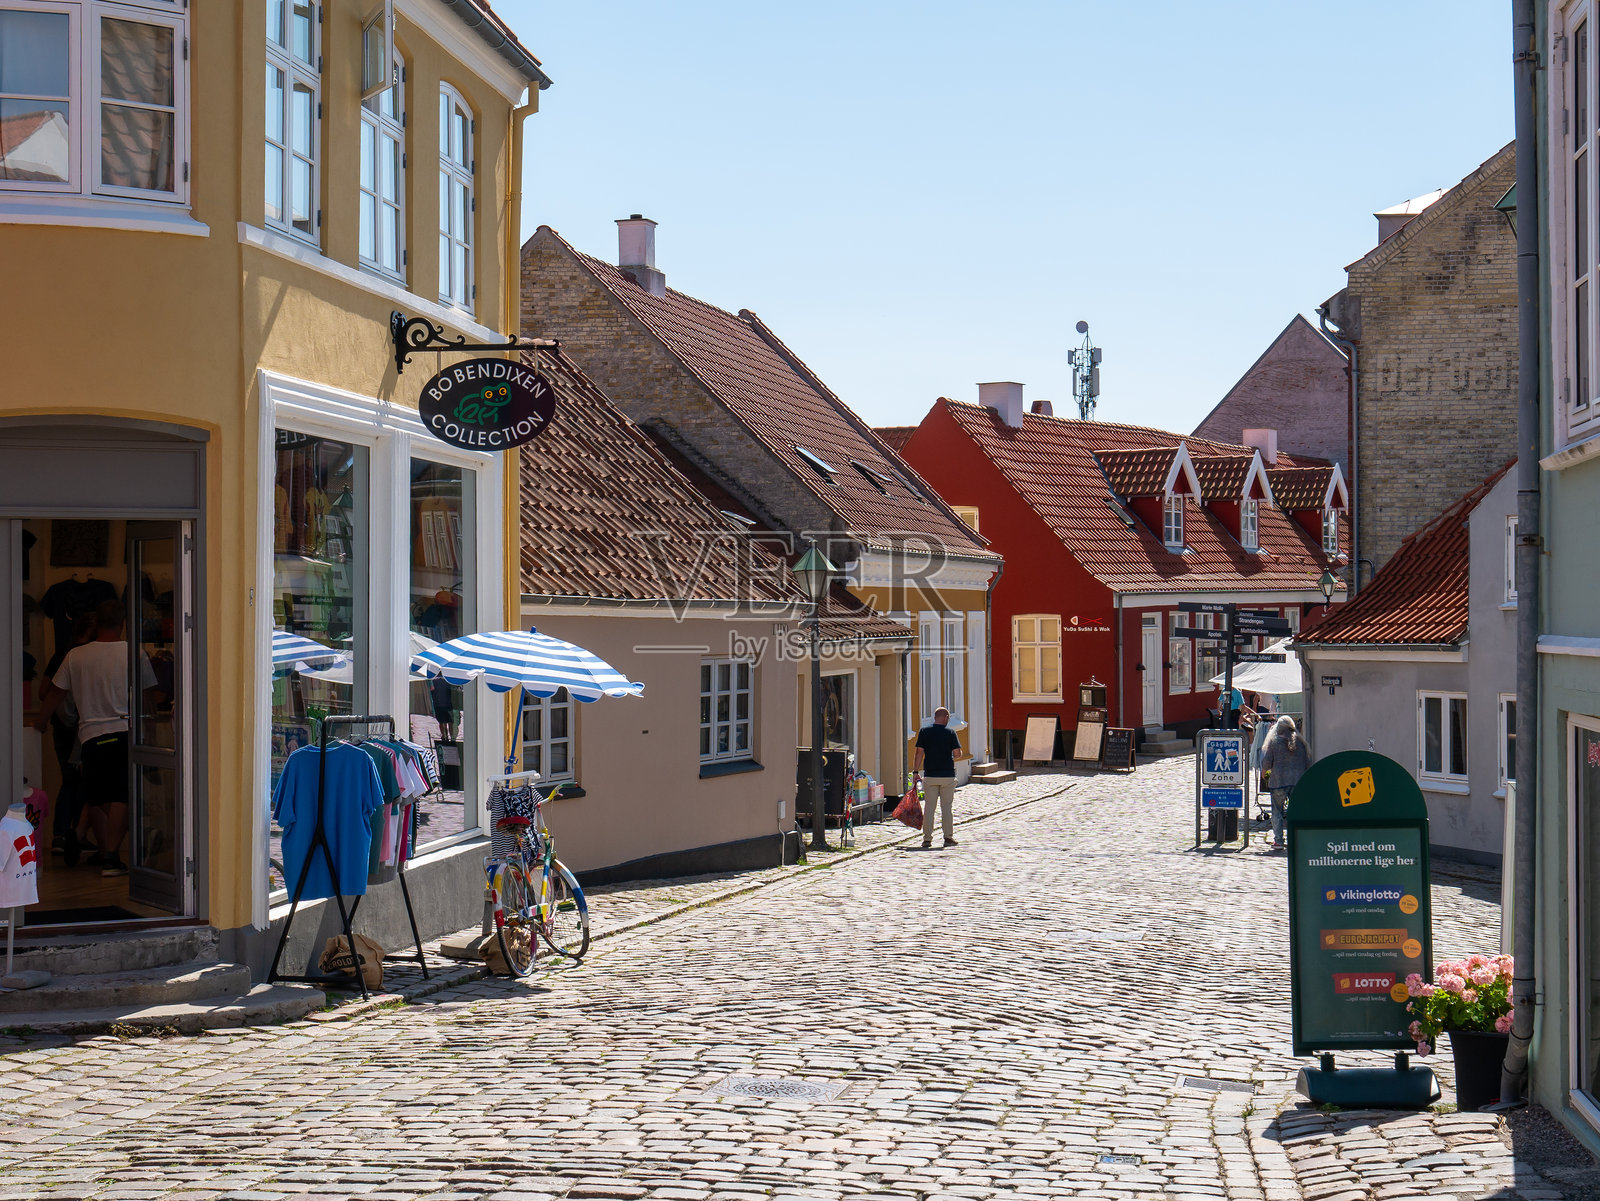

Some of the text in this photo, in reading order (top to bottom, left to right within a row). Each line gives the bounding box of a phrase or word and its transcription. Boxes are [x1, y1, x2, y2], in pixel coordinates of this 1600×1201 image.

[428, 363, 547, 401] BO BENDIXEN
[431, 410, 545, 446] COLLECTION
[1211, 773, 1234, 781] Zone
[1327, 842, 1348, 854] Spil
[1351, 842, 1375, 852] med
[1308, 856, 1415, 869] millionerne lige her
[1339, 889, 1400, 902] vikinglotto
[1354, 978, 1390, 988] LOTTO
